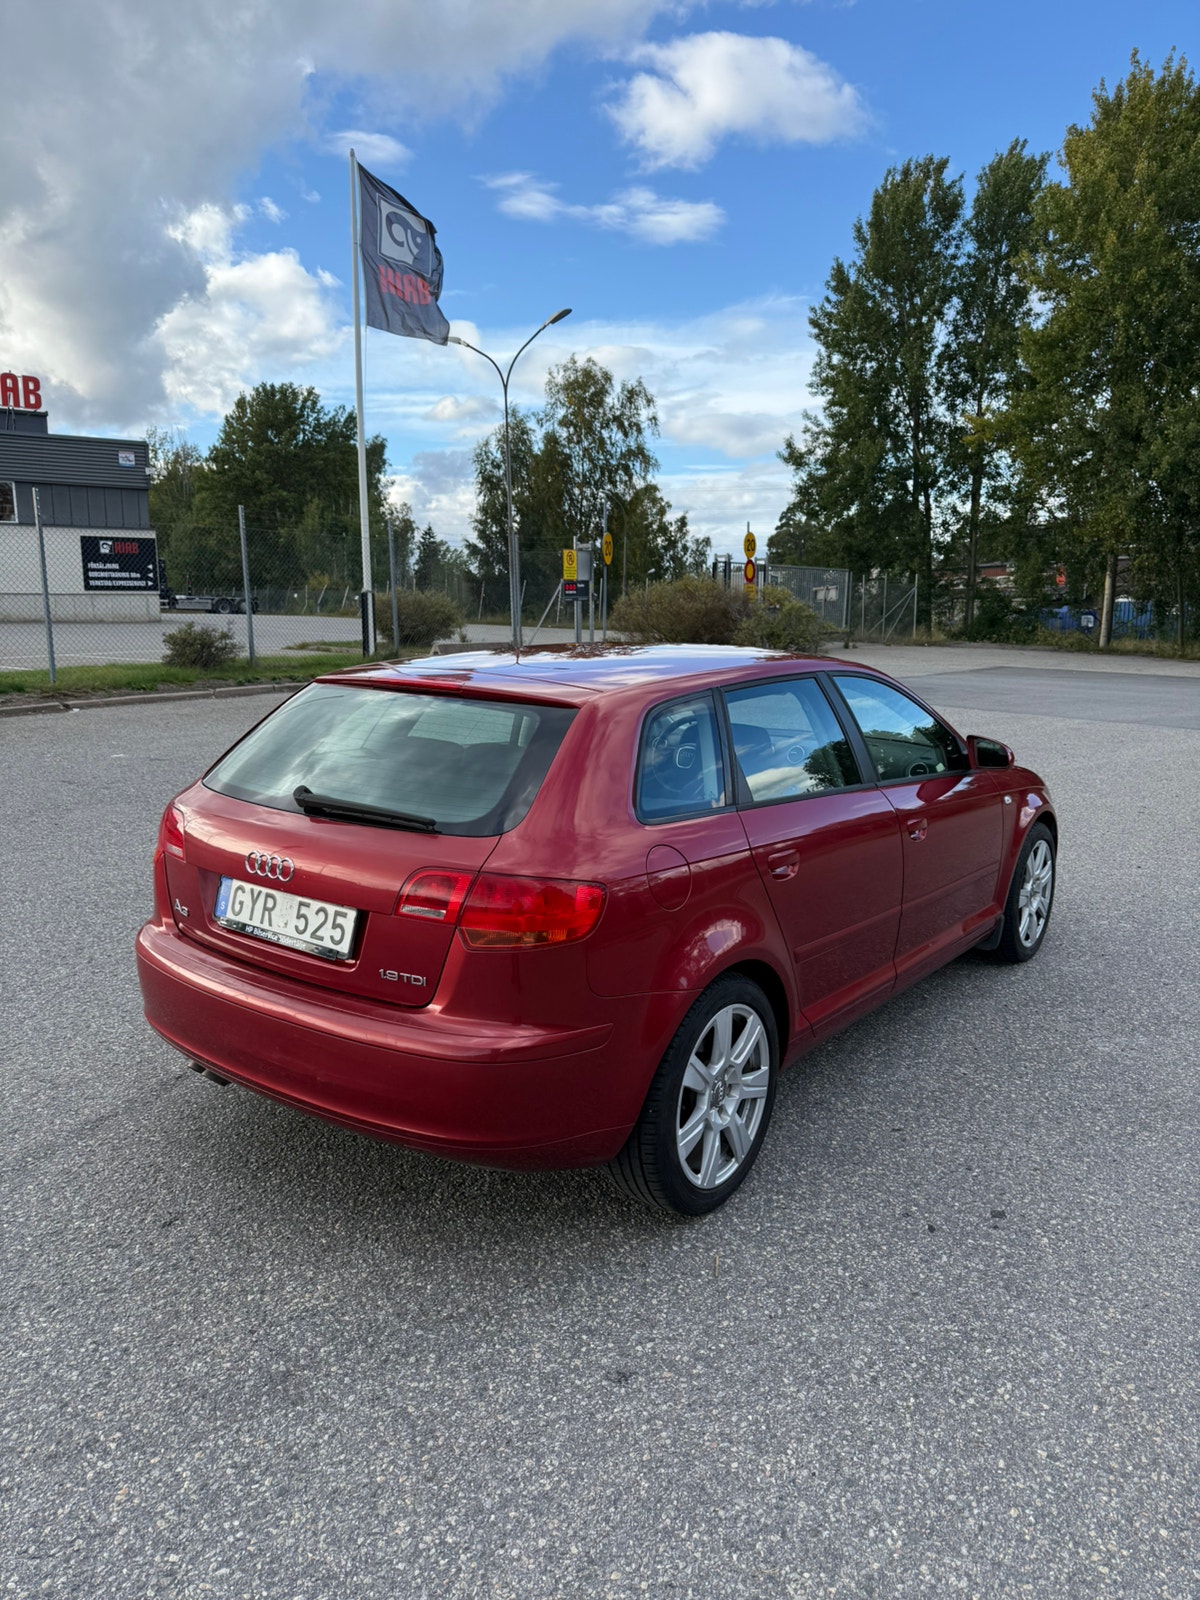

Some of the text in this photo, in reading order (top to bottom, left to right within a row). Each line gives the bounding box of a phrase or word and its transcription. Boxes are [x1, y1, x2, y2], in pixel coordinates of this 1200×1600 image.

[378, 264, 431, 305] HIAB
[604, 540, 612, 556] 20
[747, 538, 756, 552] 20
[174, 898, 188, 917] A3
[220, 901, 225, 910] S
[230, 884, 348, 946] GYR 525
[378, 968, 427, 987] 1.9 TDI
